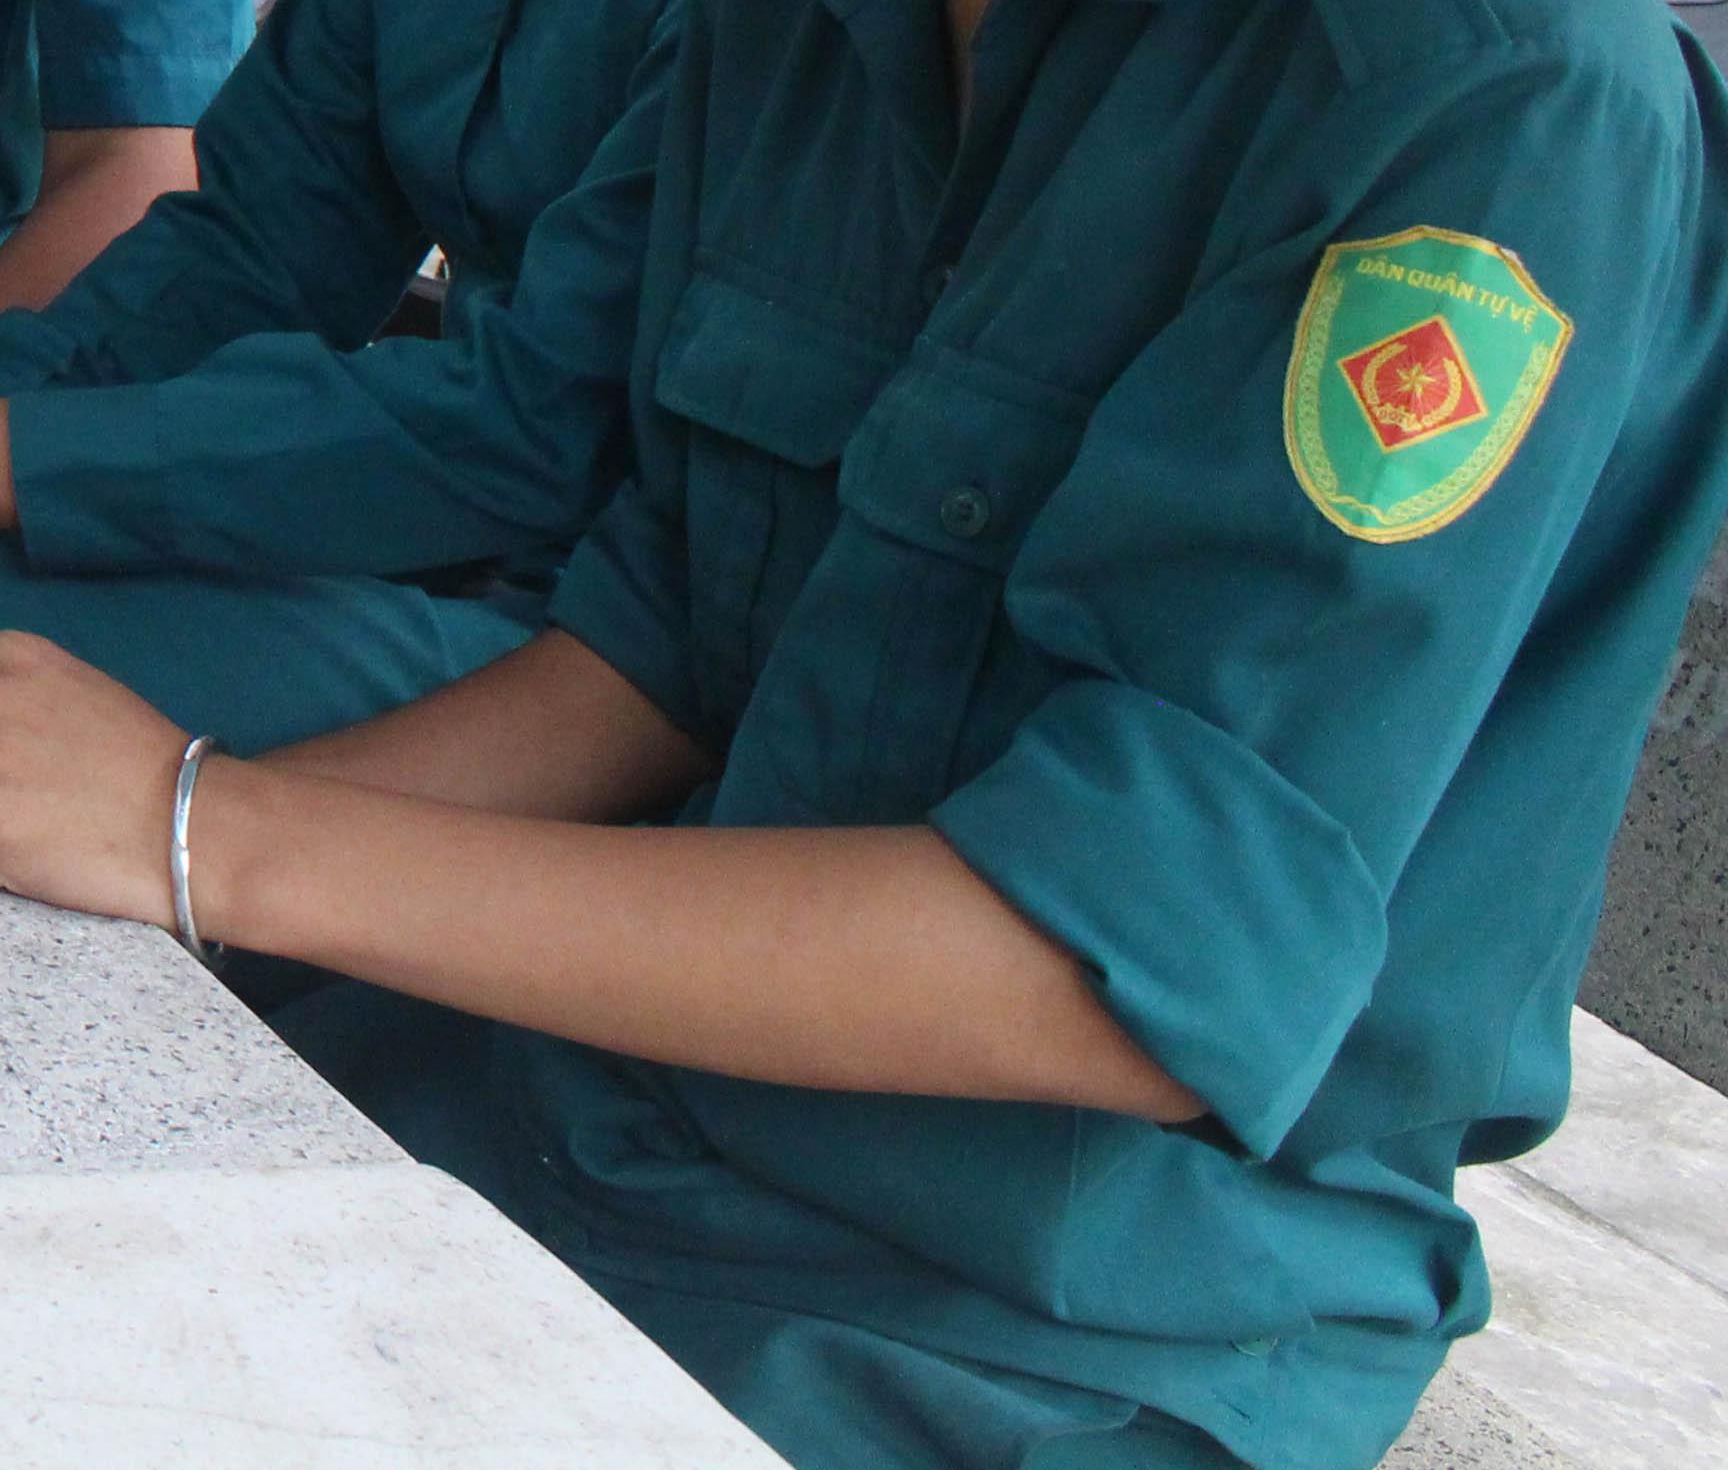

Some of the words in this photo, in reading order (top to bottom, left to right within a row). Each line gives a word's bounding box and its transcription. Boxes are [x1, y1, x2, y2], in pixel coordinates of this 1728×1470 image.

[1356, 255, 1405, 281] DÂN
[1407, 271, 1477, 303] QUÂN
[1478, 288, 1510, 319] TỰ
[1510, 302, 1538, 335] VỆ
